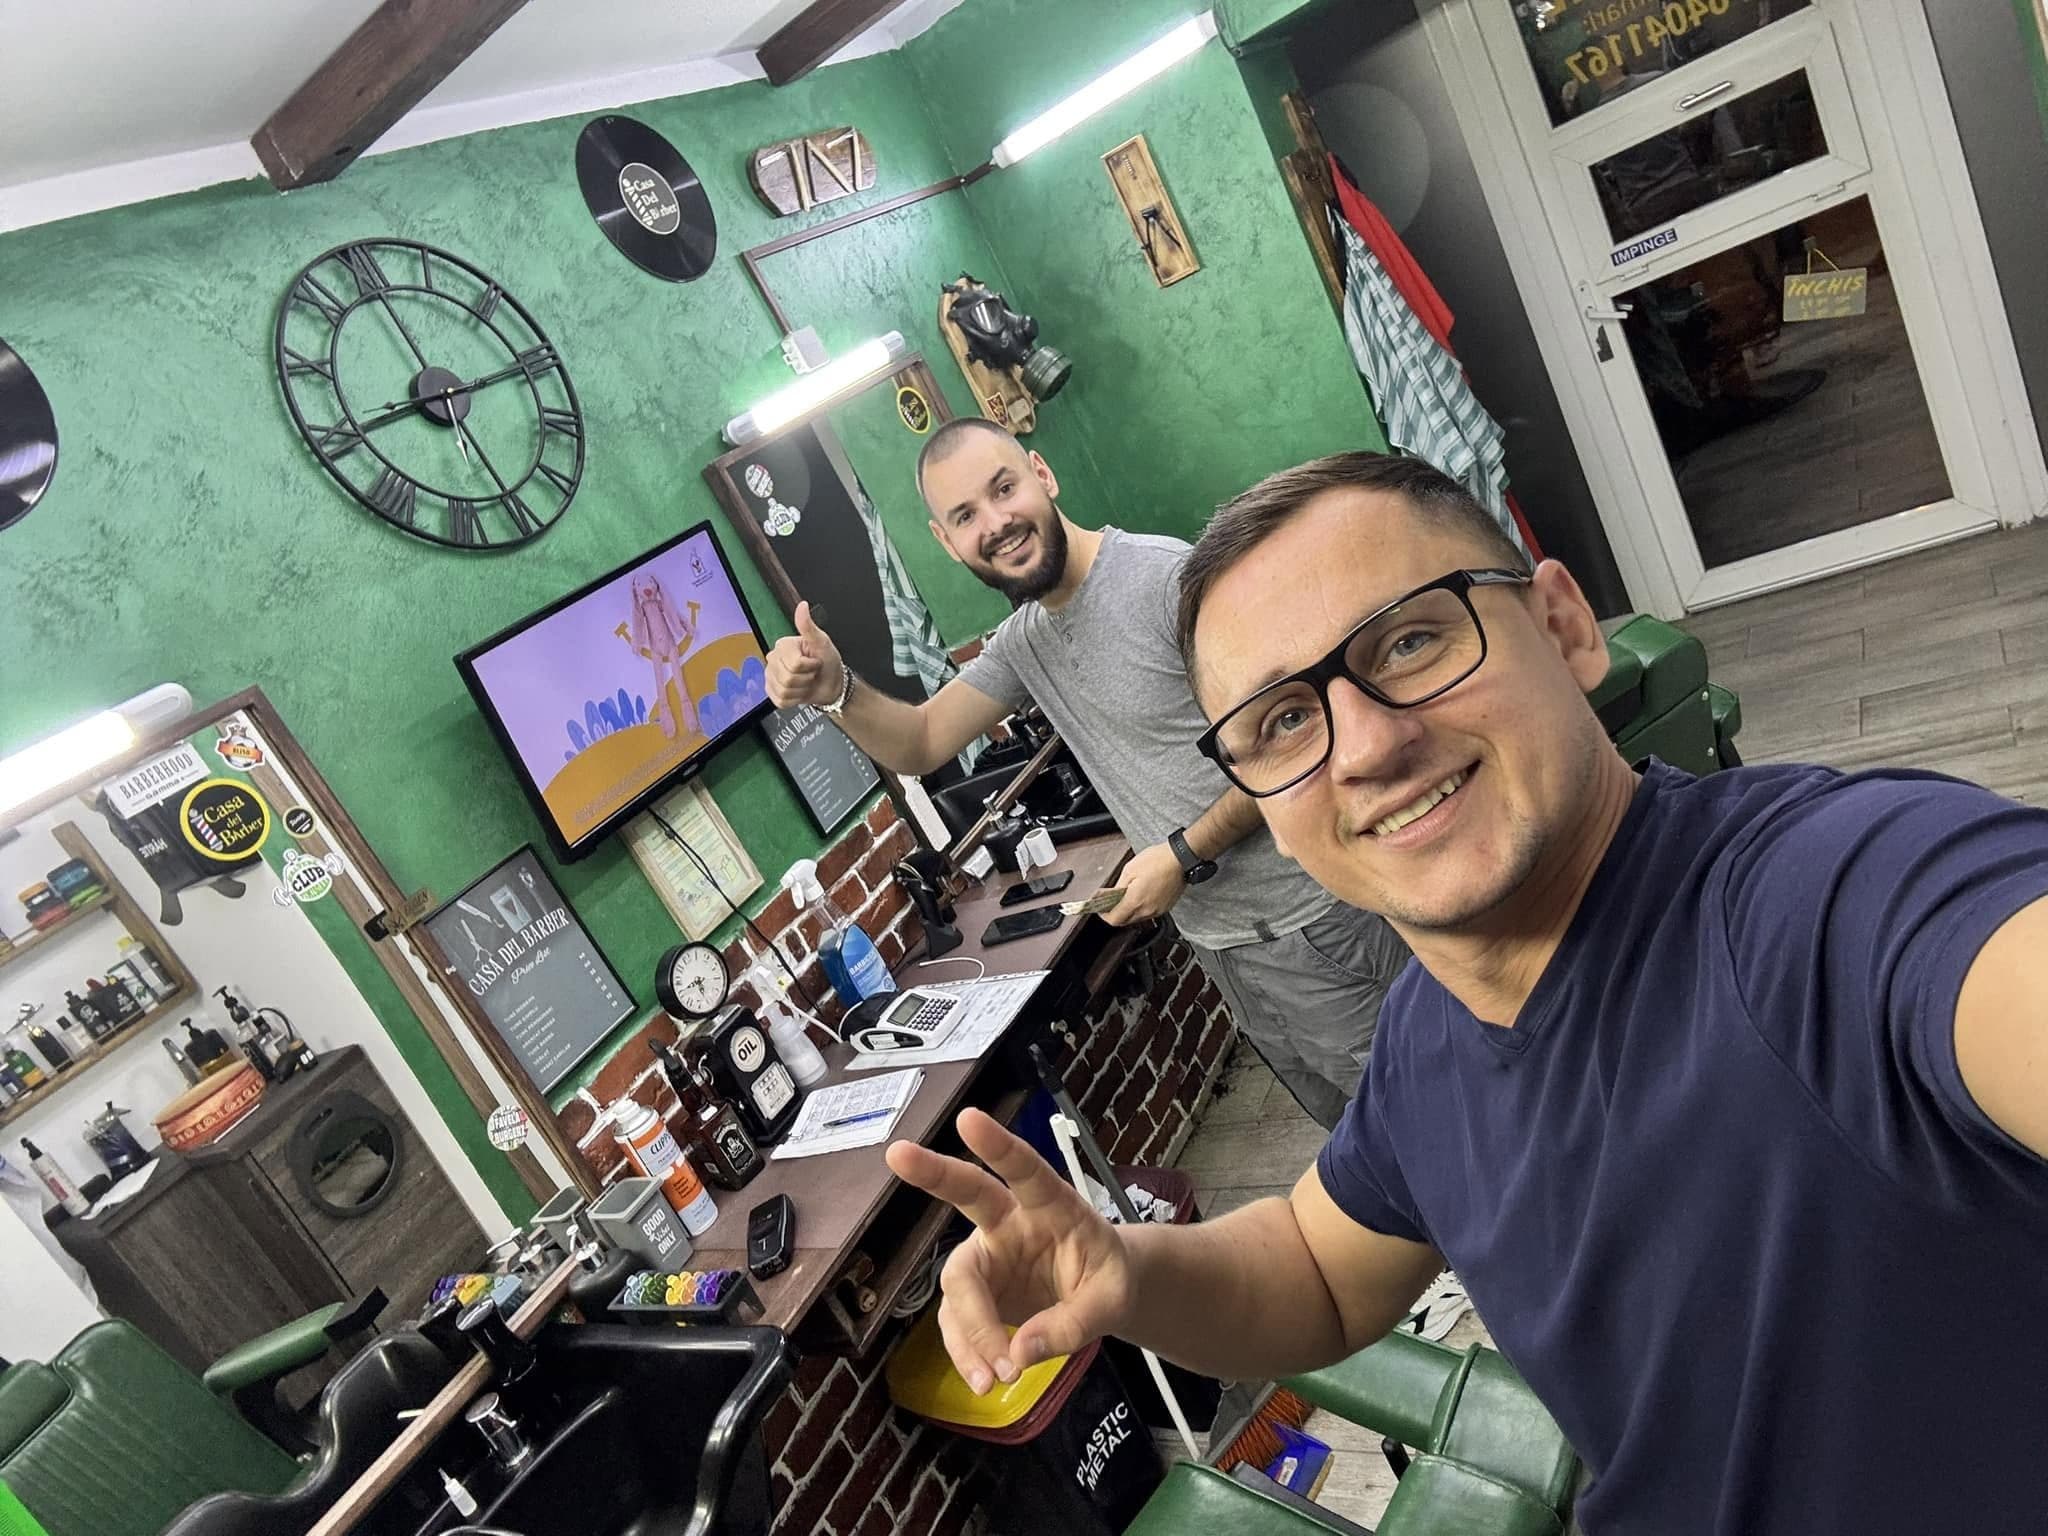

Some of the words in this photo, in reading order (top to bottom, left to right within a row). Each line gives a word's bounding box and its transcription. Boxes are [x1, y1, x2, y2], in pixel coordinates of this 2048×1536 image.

[1613, 230, 1675, 265] IMPINGE
[119, 752, 193, 800] BARBERHOOD
[203, 795, 245, 824] Casa
[226, 813, 243, 829] del
[291, 866, 325, 892] CLUB
[468, 957, 505, 996] CASA
[497, 937, 526, 966] DEL
[520, 907, 569, 948] BARBER
[738, 1040, 758, 1062] OIL
[642, 1208, 666, 1237] GOOD
[657, 1233, 677, 1255] ONLY
[1075, 1401, 1129, 1487] PLASTIC
[1086, 1425, 1132, 1492] METAL
